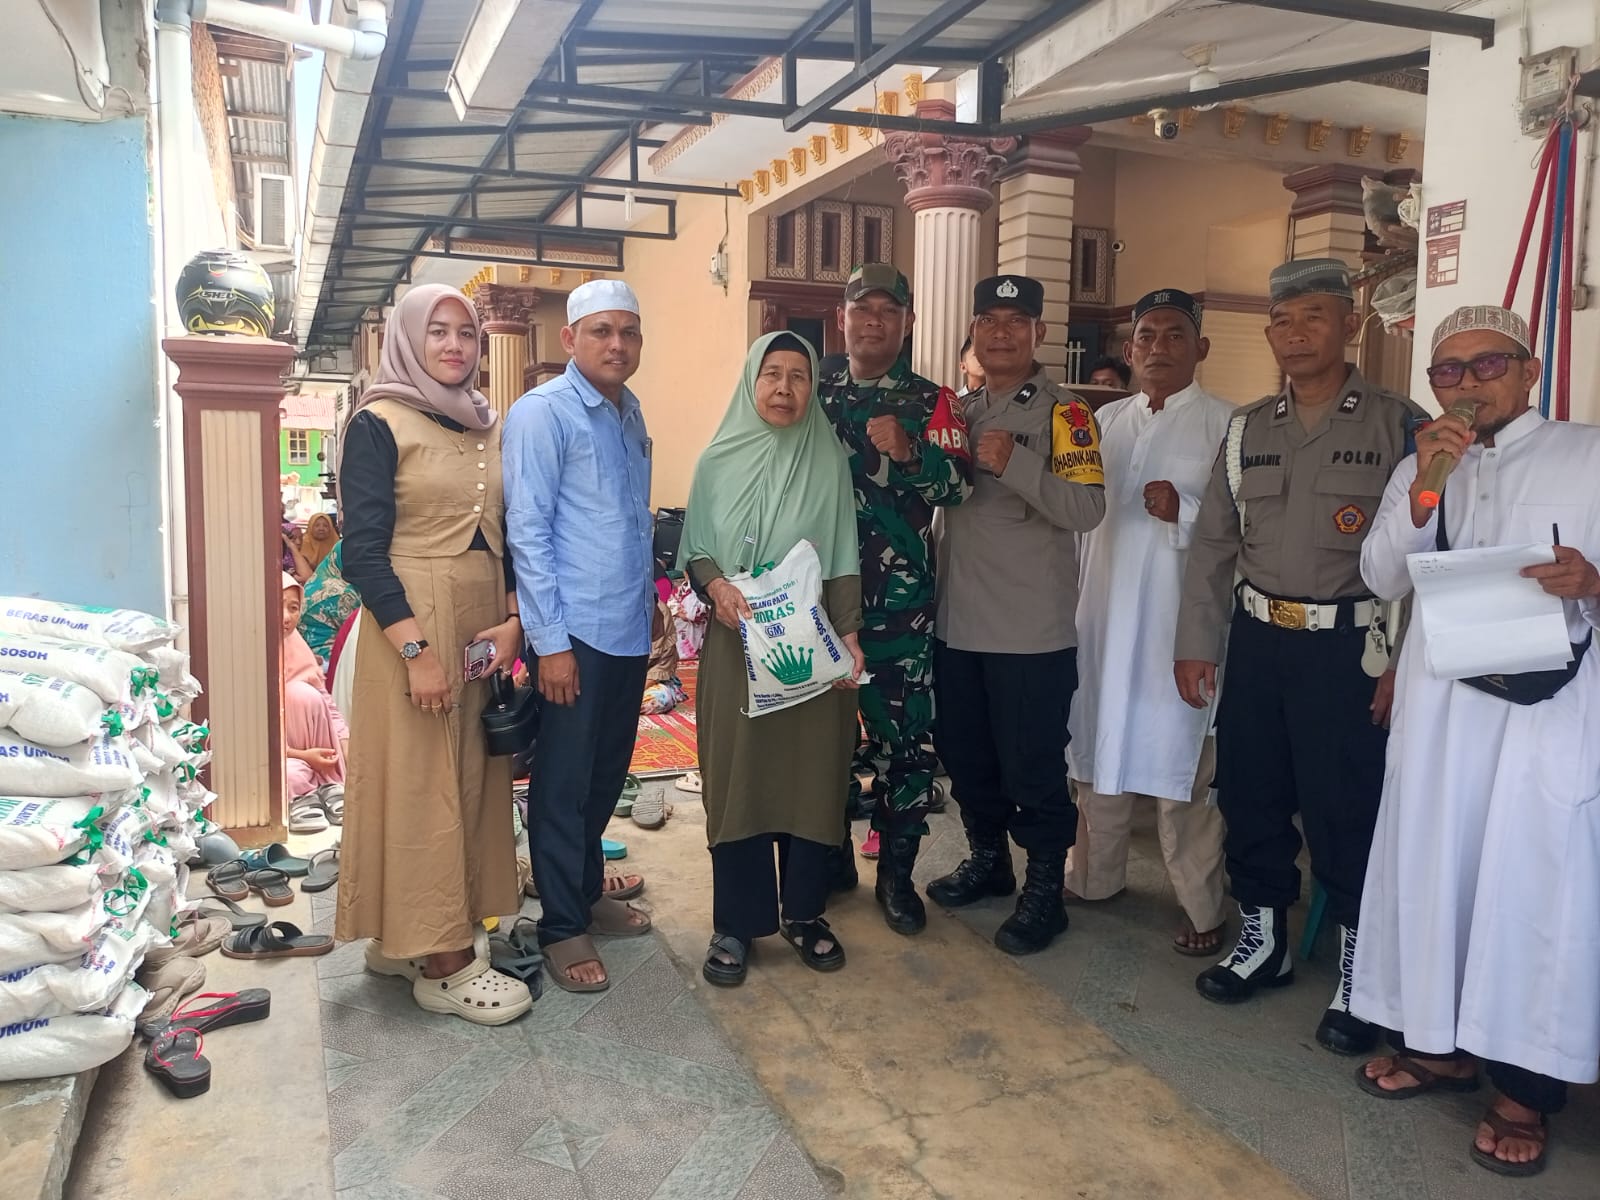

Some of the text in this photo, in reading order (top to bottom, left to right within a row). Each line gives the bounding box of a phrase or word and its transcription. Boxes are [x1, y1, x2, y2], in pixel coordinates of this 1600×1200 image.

[1332, 451, 1381, 465] POLRI
[772, 592, 789, 605] PADI
[6, 608, 48, 622] BERAS
[51, 616, 90, 631] UMUM
[767, 625, 783, 637] GM
[0, 648, 48, 660] SOSOH
[822, 633, 841, 663] BERAS
